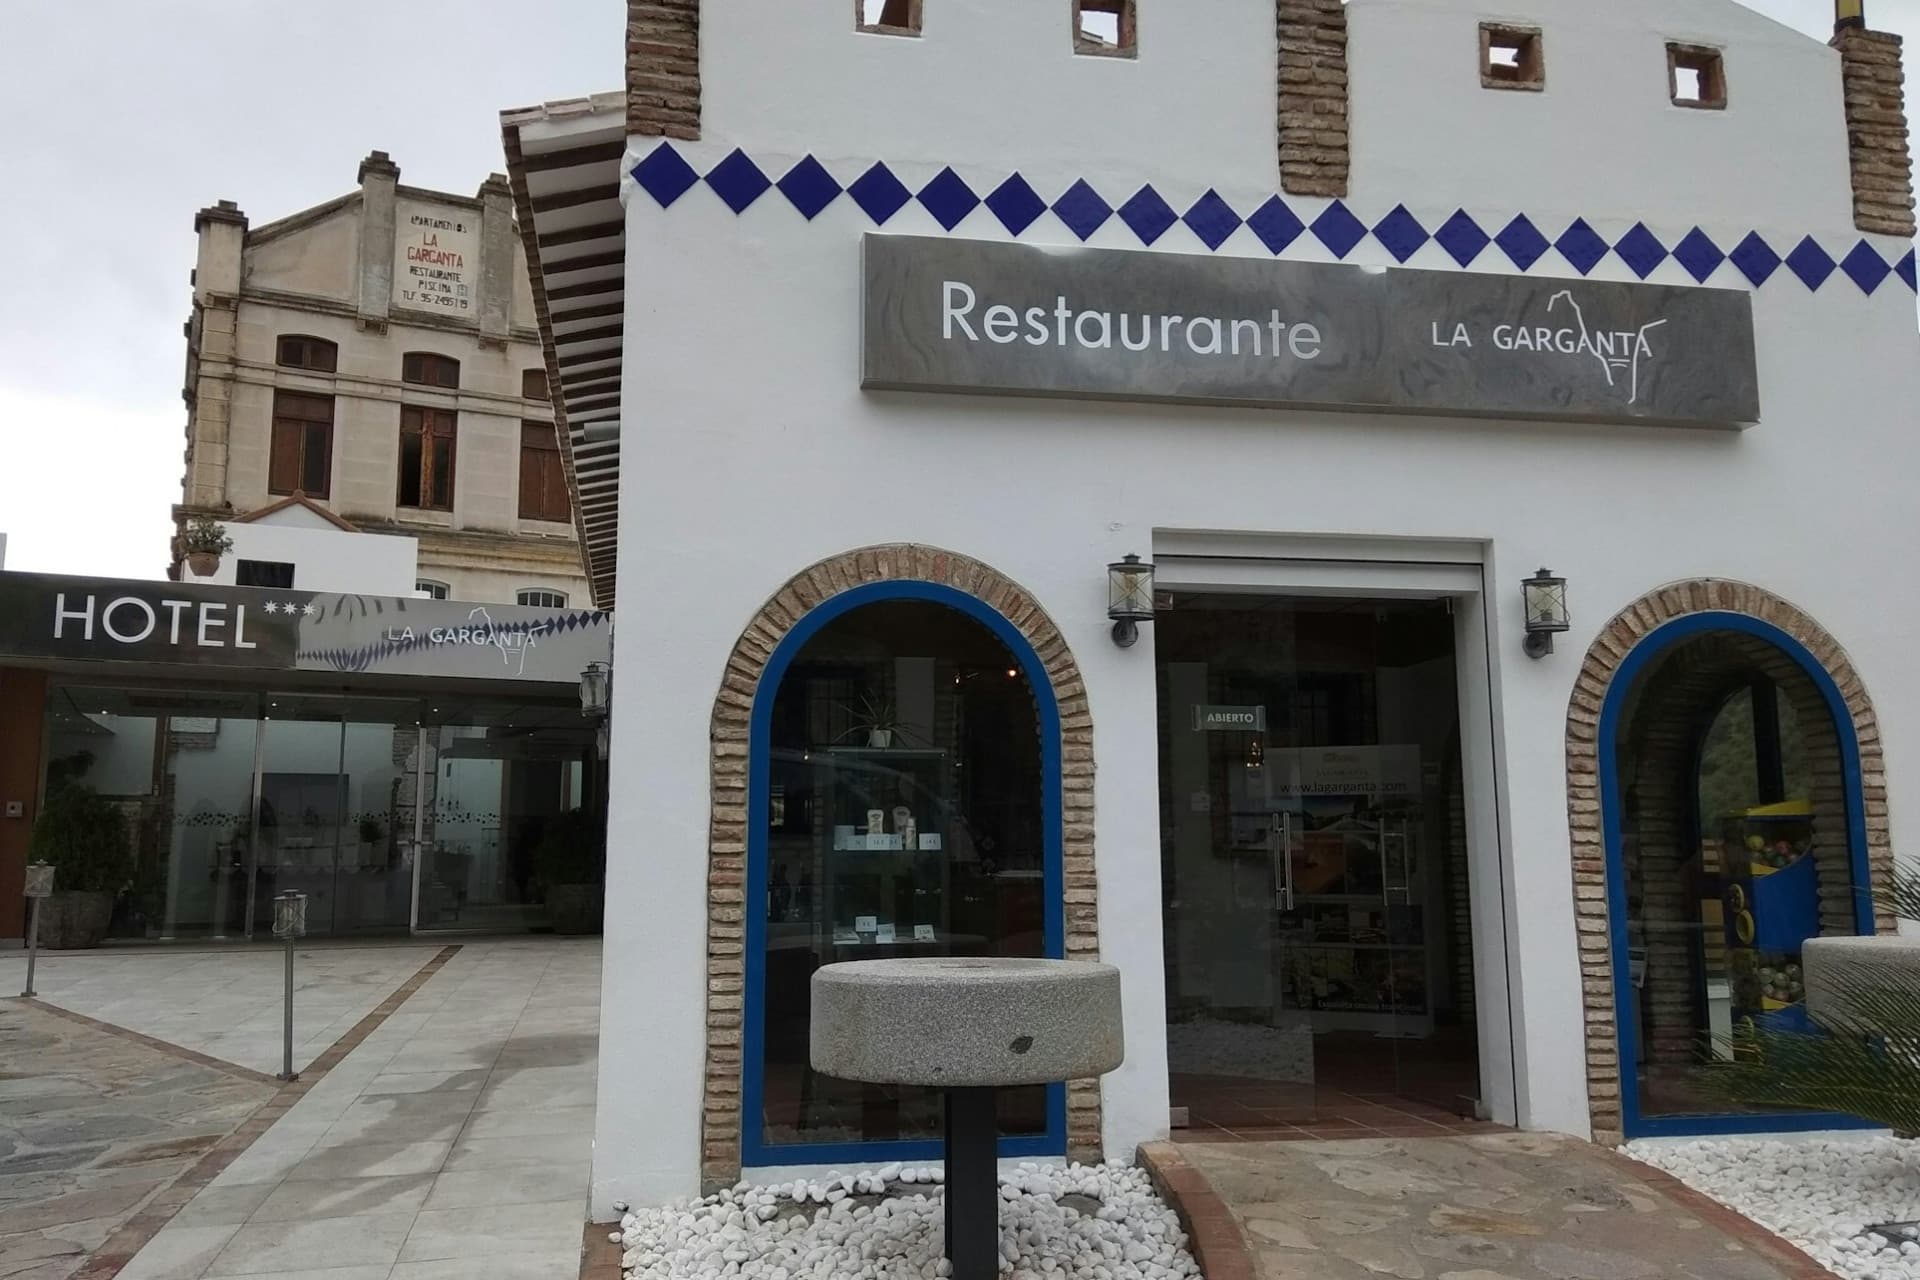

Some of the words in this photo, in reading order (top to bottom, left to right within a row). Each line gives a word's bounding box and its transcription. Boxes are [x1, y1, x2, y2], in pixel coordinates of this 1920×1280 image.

[423, 232, 438, 247] LA
[407, 246, 464, 268] GARGANTA
[409, 265, 462, 283] RESTAURANTE
[418, 279, 452, 293] PISCINA
[943, 281, 1321, 359] Restaurante
[1432, 321, 1472, 348] LA
[1493, 324, 1653, 357] GARGANTA
[54, 593, 257, 648] HOTEL
[388, 625, 415, 642] LA
[430, 627, 536, 648] GARGANTA
[1207, 712, 1255, 723] ABIERTO
